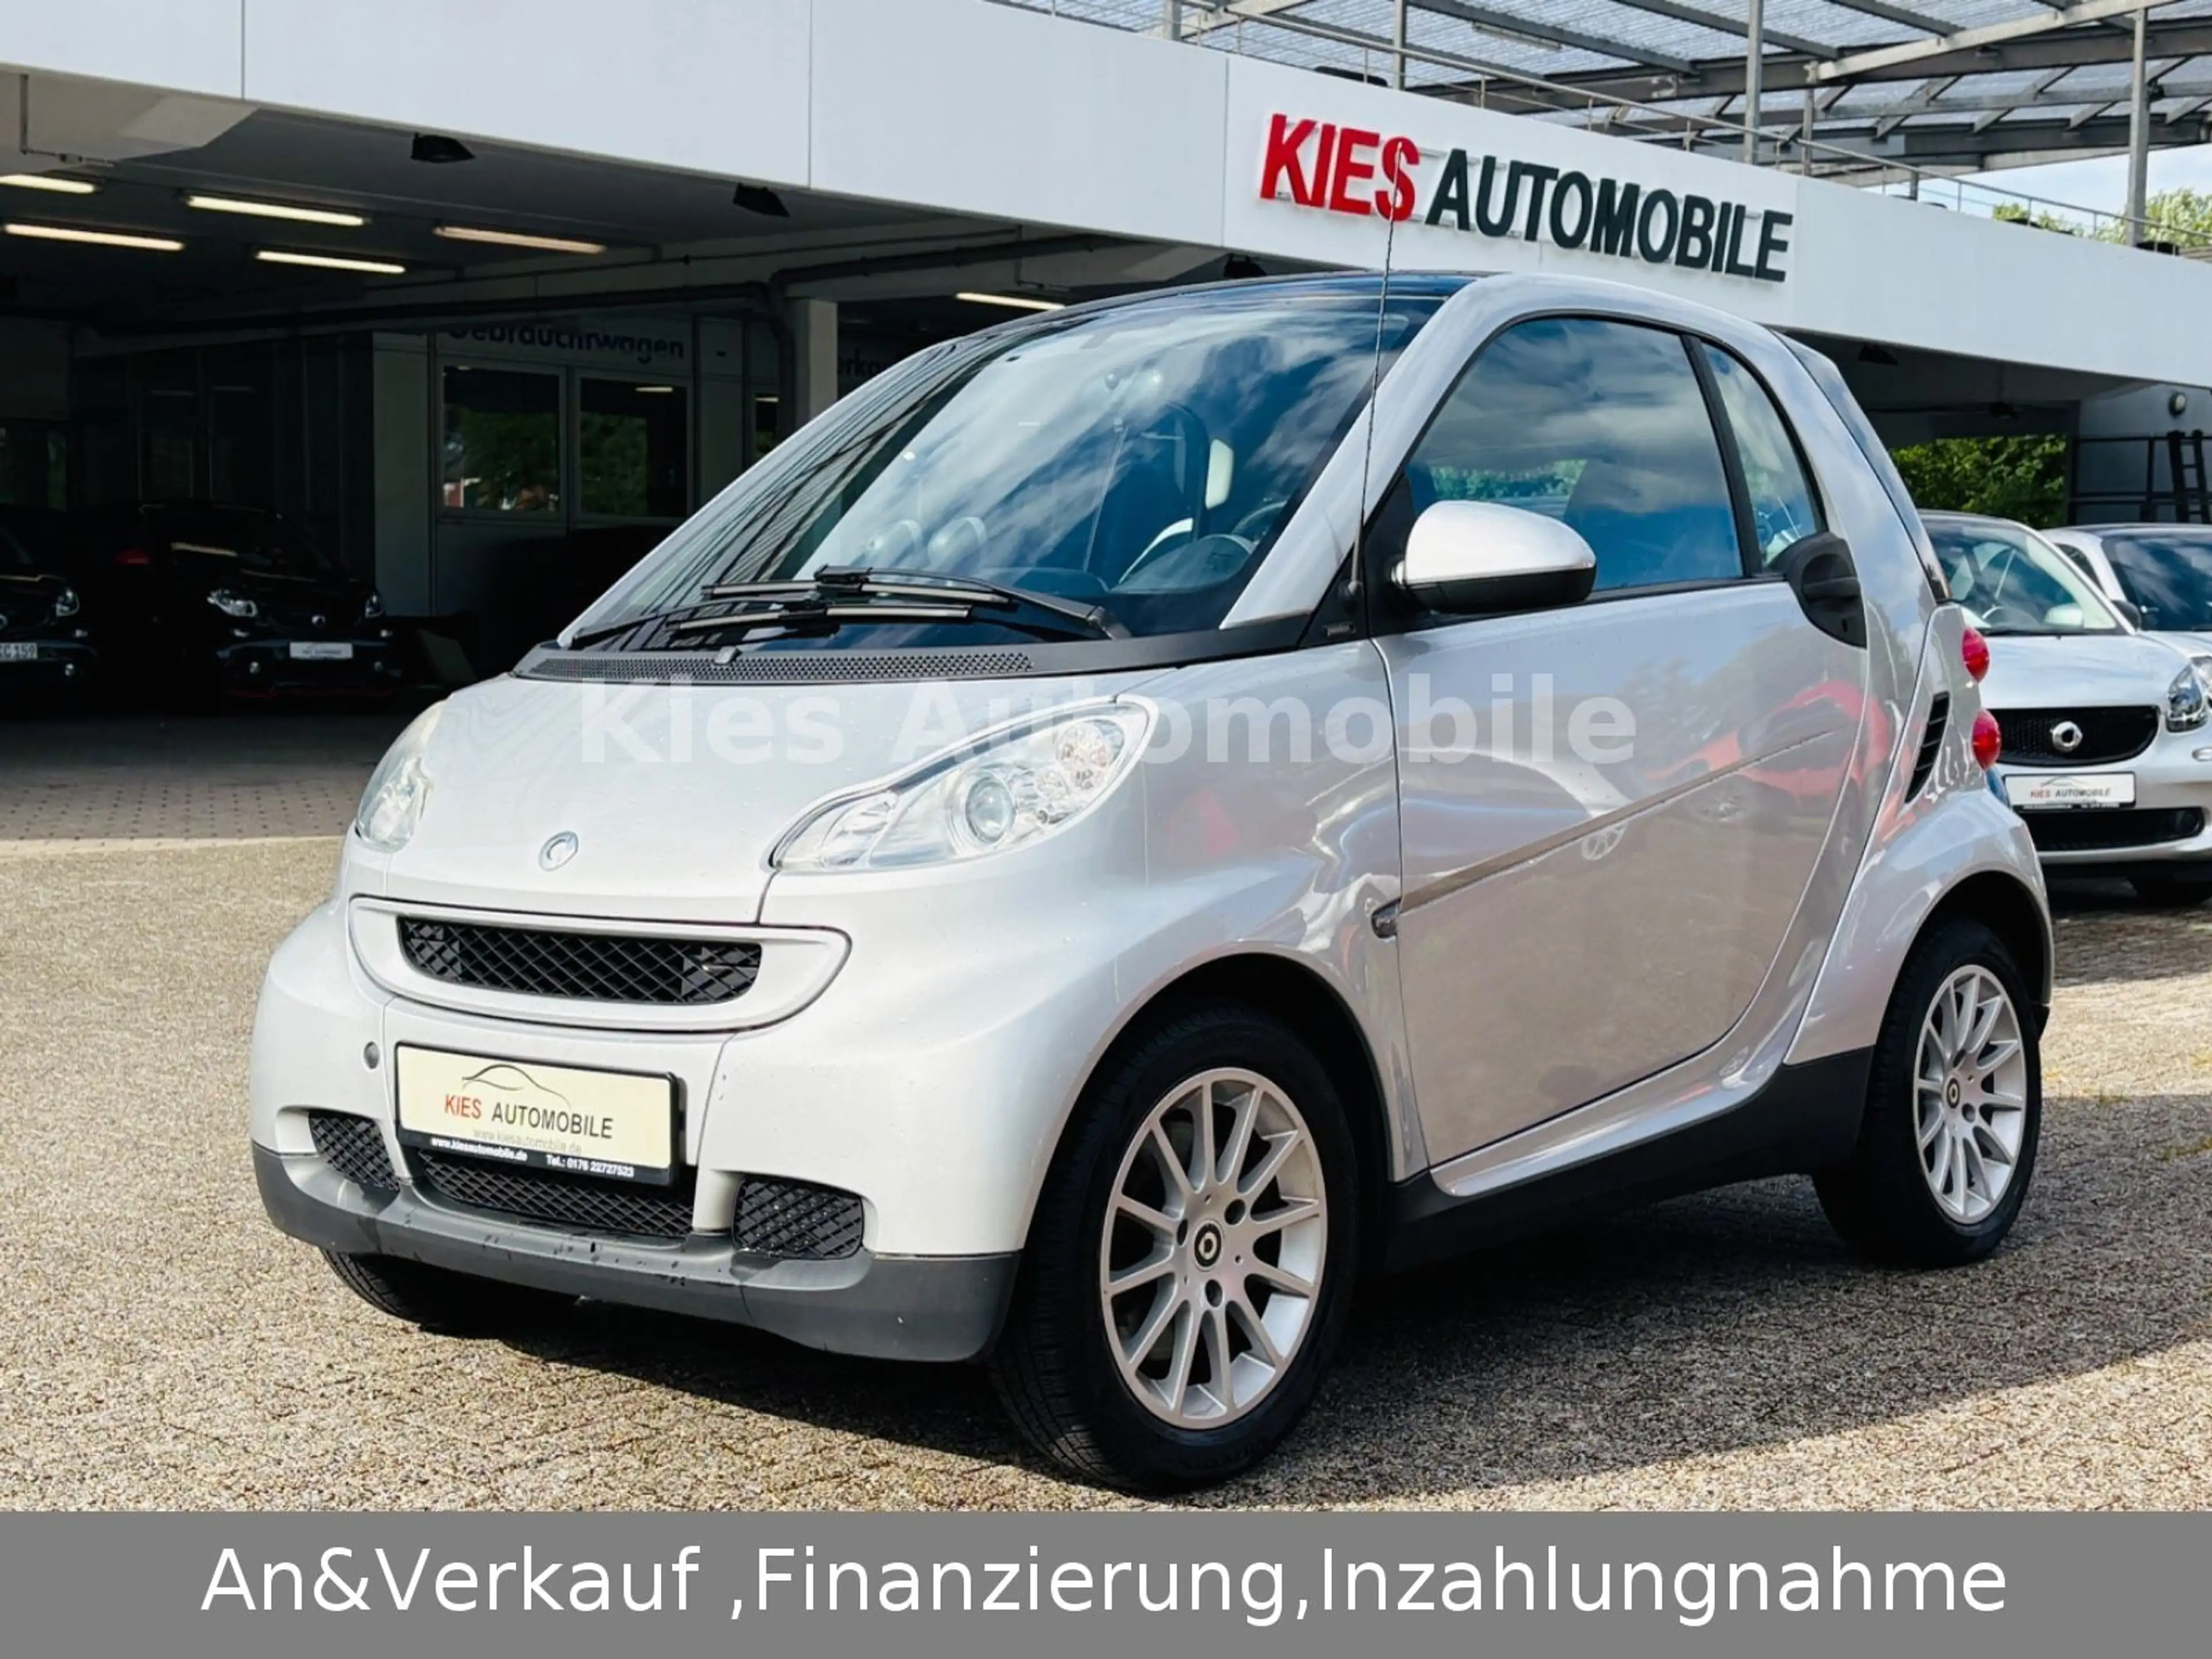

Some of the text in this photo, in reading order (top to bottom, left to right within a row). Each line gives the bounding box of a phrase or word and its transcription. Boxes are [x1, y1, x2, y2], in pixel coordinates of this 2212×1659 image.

[1260, 113, 1793, 282] KIES AUTOMOBILE
[445, 1094, 613, 1138] KIES AUTOMOBILE
